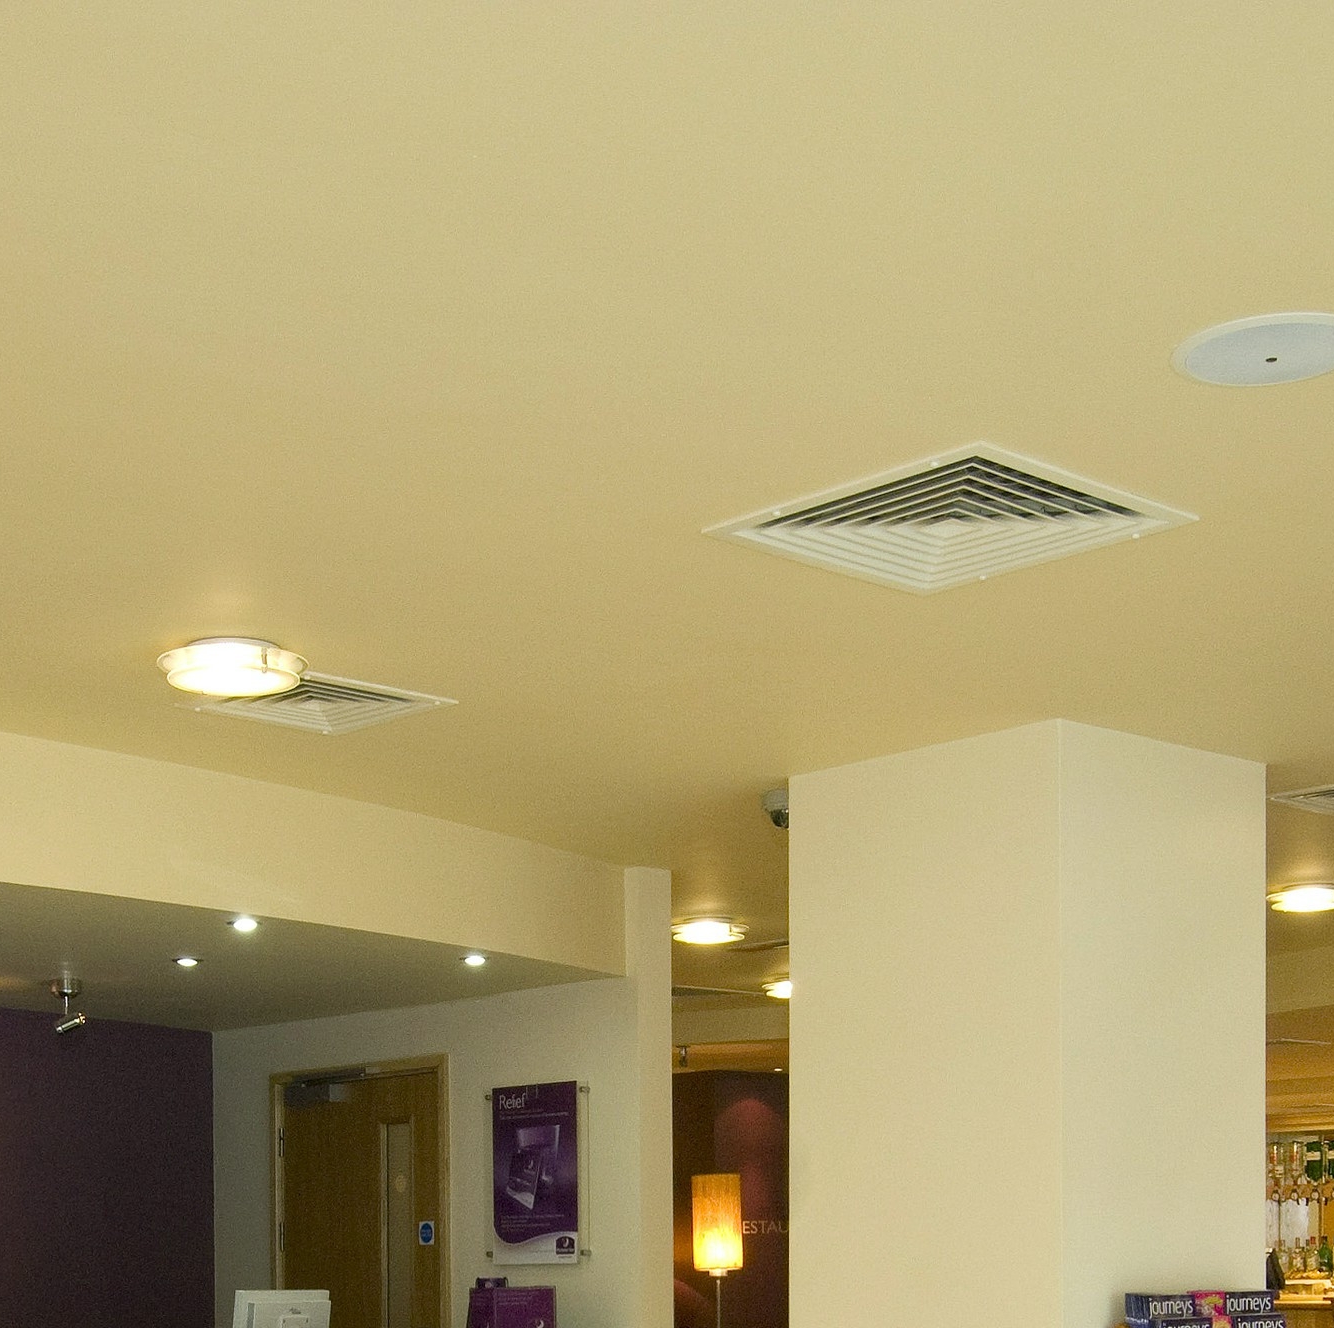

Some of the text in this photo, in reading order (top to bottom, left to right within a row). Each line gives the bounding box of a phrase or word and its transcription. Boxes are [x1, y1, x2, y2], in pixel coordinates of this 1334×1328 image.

[742, 1220, 788, 1234] ESTAU
[1149, 1298, 1194, 1319] journeys
[1226, 1295, 1271, 1314] journeys
